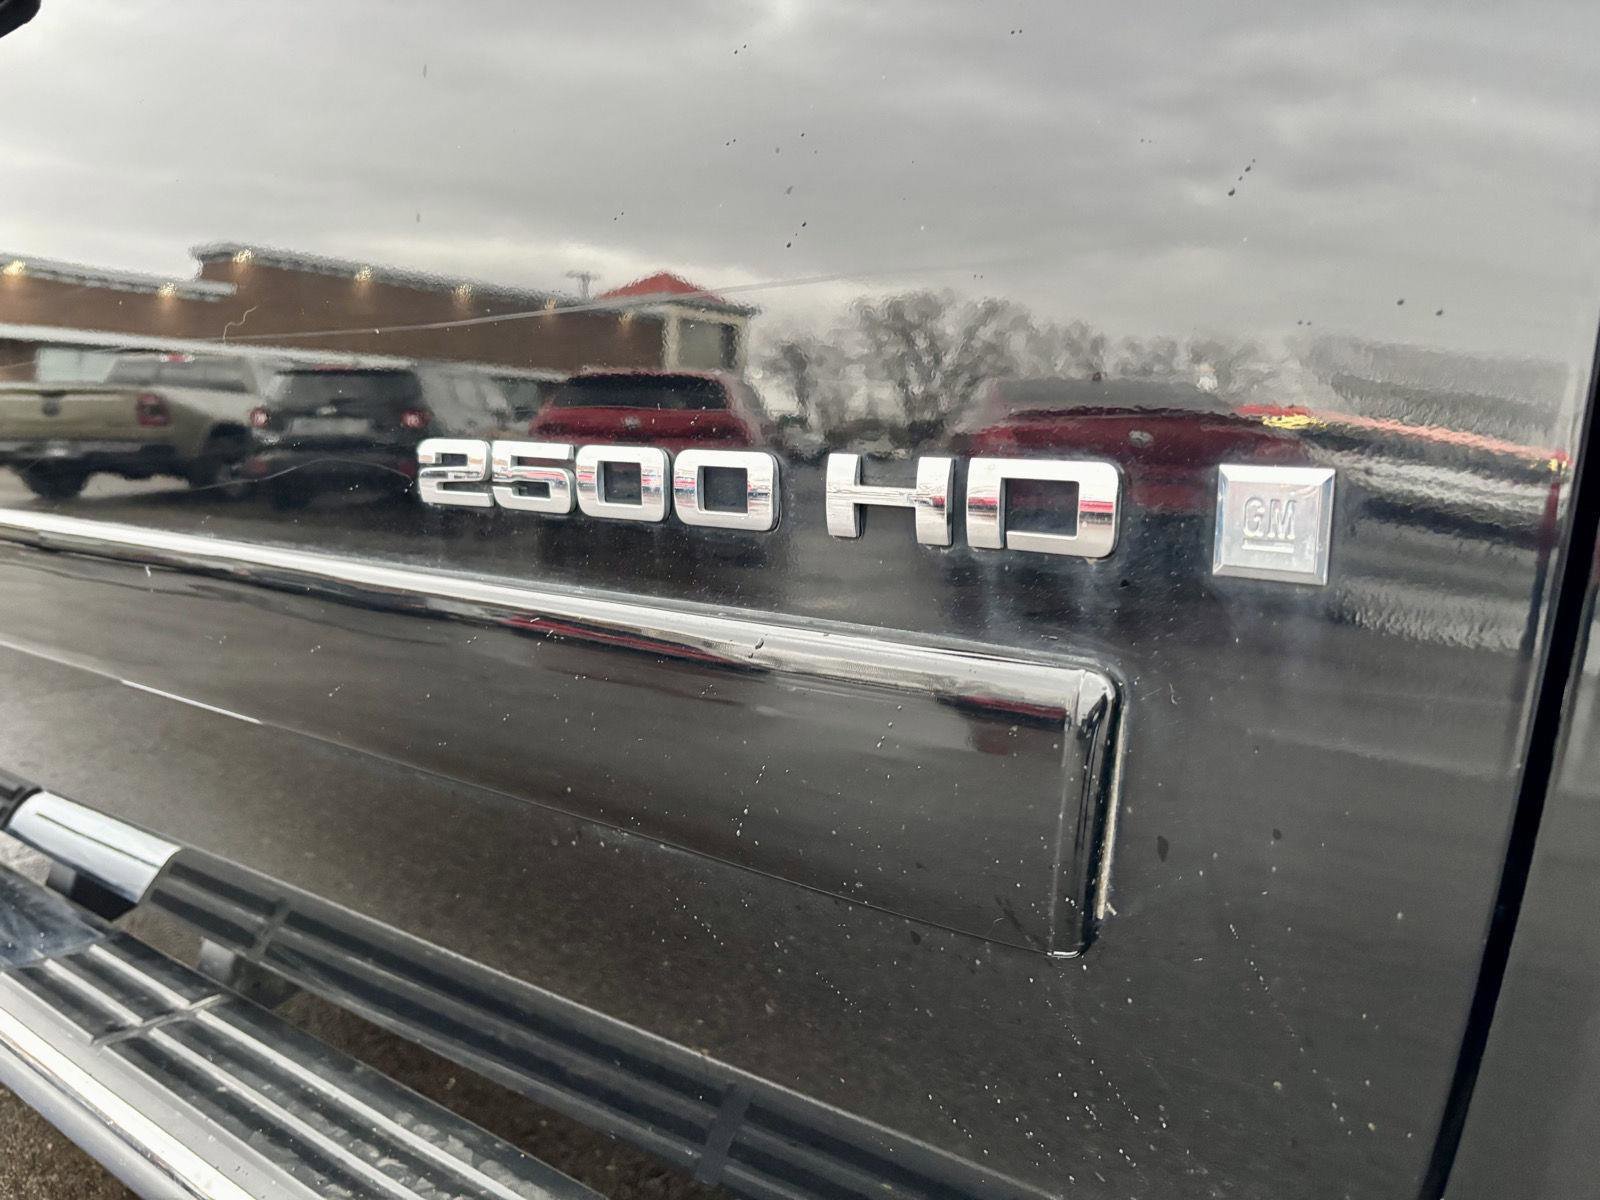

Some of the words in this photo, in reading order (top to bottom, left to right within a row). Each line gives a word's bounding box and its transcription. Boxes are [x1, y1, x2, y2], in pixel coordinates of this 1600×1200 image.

[418, 438, 781, 532] 2500
[826, 453, 1122, 558] HD
[1243, 495, 1297, 539] GM
